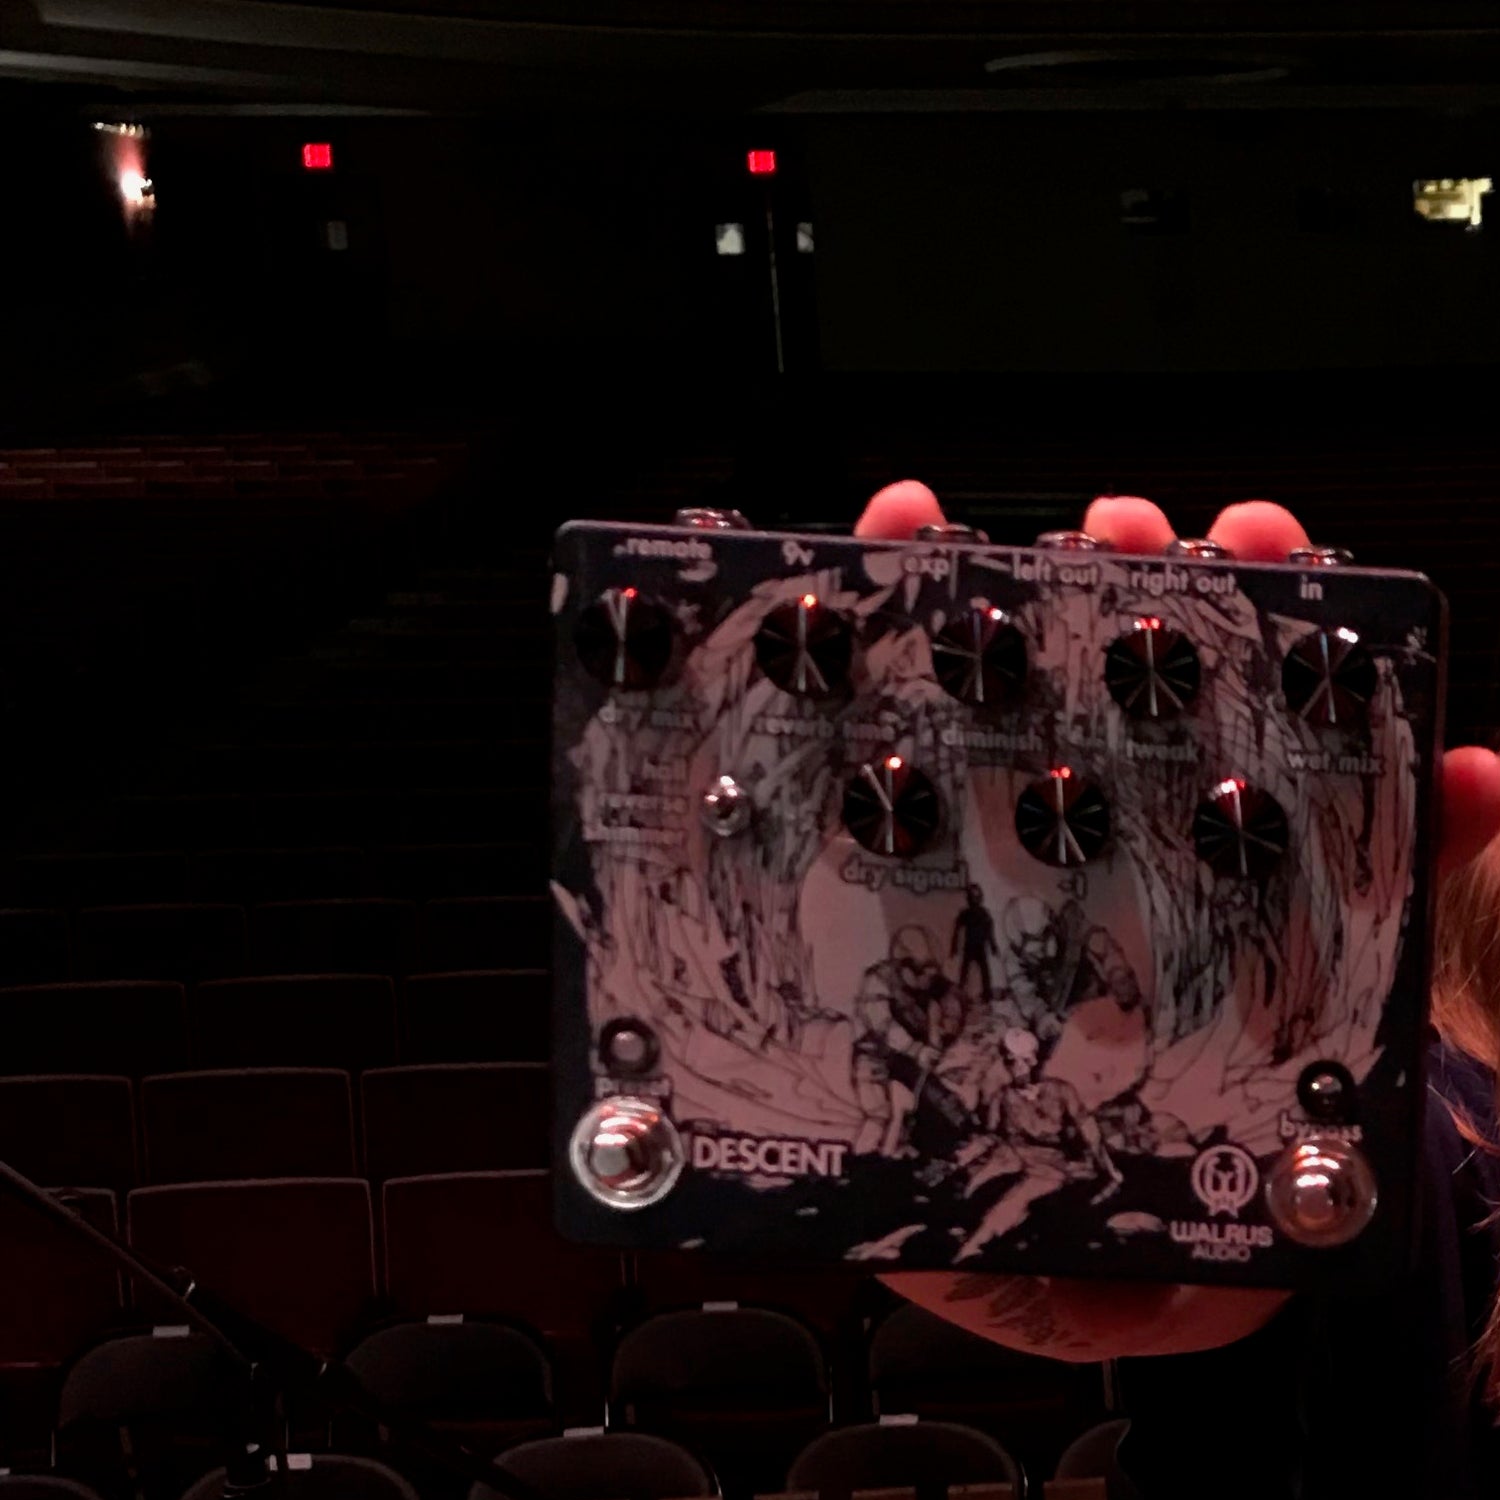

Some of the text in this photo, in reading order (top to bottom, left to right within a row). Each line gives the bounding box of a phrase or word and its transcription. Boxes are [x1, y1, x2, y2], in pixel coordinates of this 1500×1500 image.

[904, 555, 949, 582] exp
[1012, 553, 1098, 586] left out
[1130, 563, 1237, 596] right out
[1300, 573, 1324, 600] in
[692, 1136, 848, 1177] DESCENT
[1168, 1221, 1274, 1248] WALRUS
[1190, 1244, 1251, 1263] AUDIO
